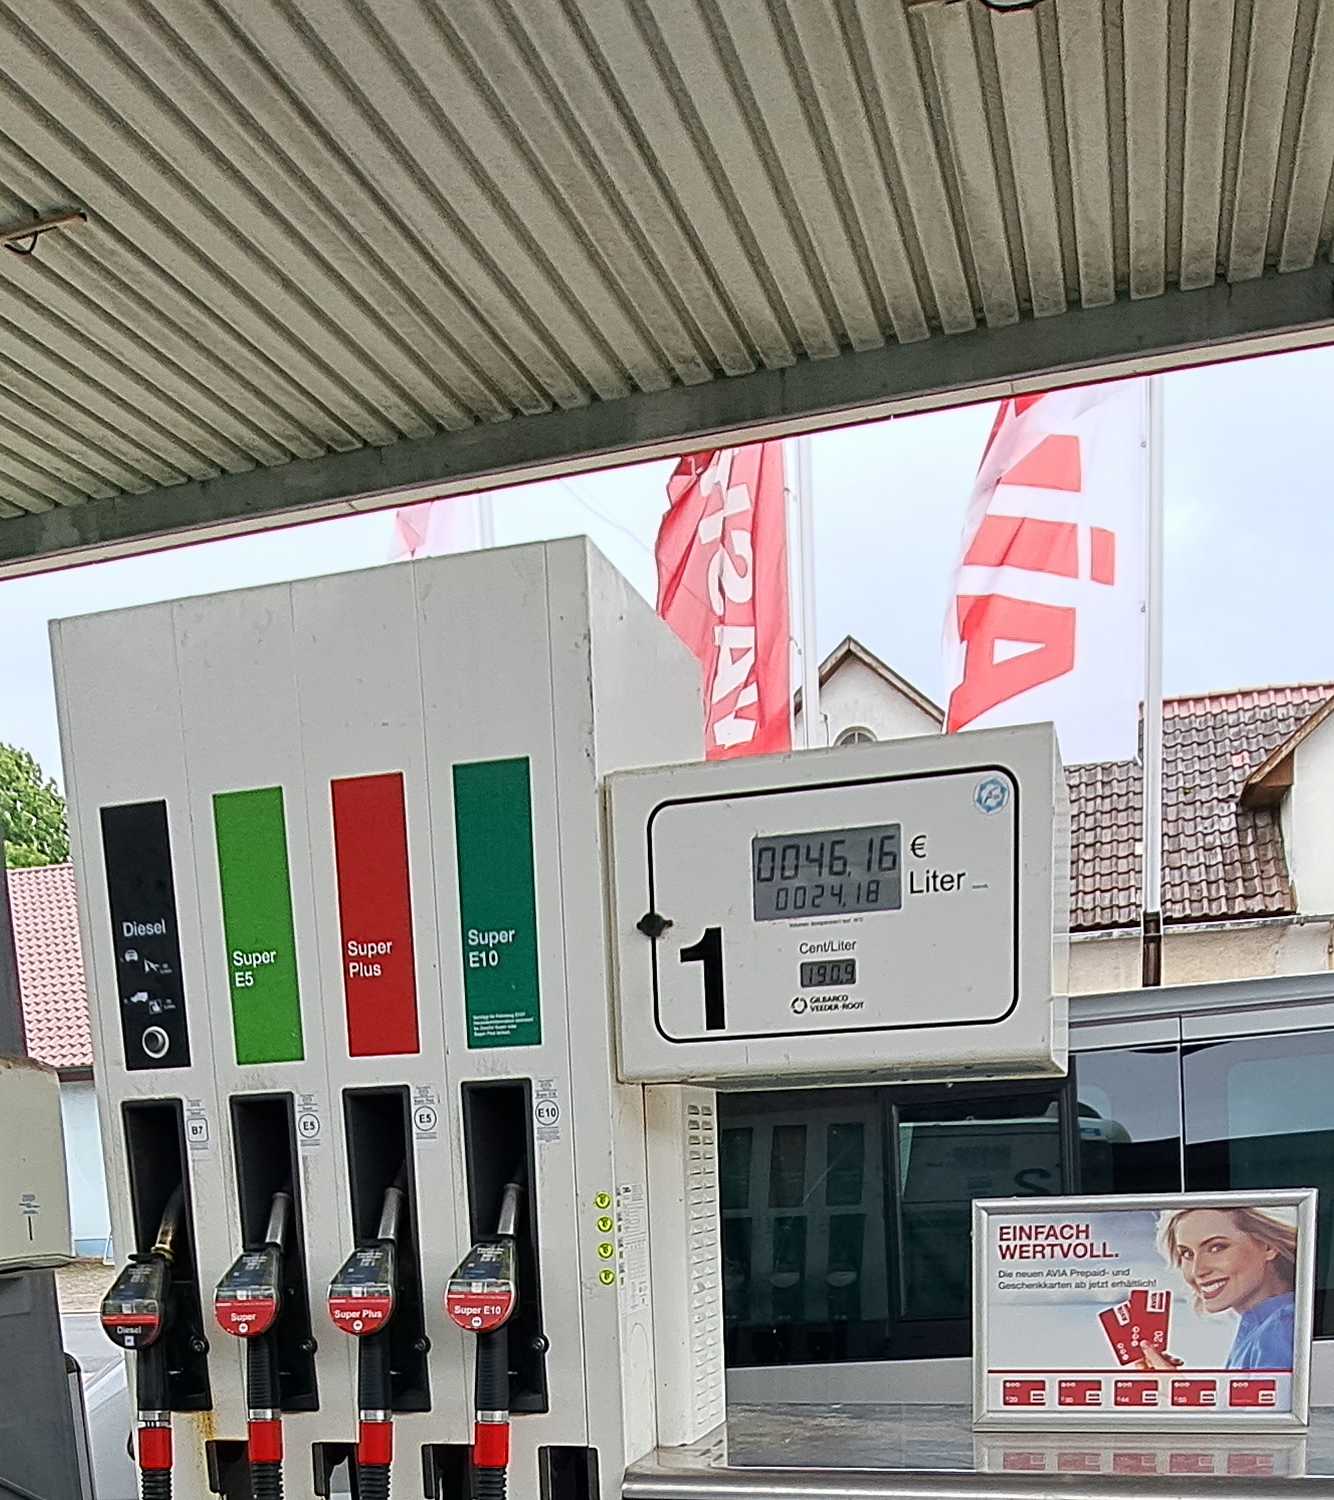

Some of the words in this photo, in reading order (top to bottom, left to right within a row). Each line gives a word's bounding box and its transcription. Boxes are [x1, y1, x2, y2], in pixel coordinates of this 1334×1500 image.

[910, 834, 927, 858] €
[910, 870, 966, 894] Liter
[122, 918, 166, 937] Diesel
[468, 929, 516, 948] Super
[347, 940, 393, 959] Super
[799, 941, 857, 954] Cent/Liter
[233, 950, 277, 968] Super
[469, 950, 499, 968] E10
[349, 961, 382, 978] Plus
[235, 971, 254, 987] E5
[680, 926, 726, 1031] 1
[809, 994, 849, 1004] GILBARCO
[419, 1114, 432, 1124] E5
[538, 1107, 556, 1118] E10
[192, 1126, 203, 1135] B7
[303, 1121, 315, 1131] E5
[998, 1223, 1091, 1242] EINFACH
[998, 1242, 1120, 1260] WERTVOLL.
[998, 1270, 1013, 1278] Die
[1046, 1269, 1068, 1277] AVIA
[1070, 1269, 1109, 1278] Prepaid-
[1112, 1268, 1130, 1276] und
[998, 1281, 1073, 1289] Geschenkkarten
[1088, 1280, 1109, 1289] jetzt
[230, 1312, 257, 1322] Super
[334, 1309, 361, 1320] Super
[362, 1309, 383, 1318] Plus
[453, 1305, 482, 1316] Super
[483, 1305, 501, 1315] E10
[117, 1325, 142, 1334] Diesel
